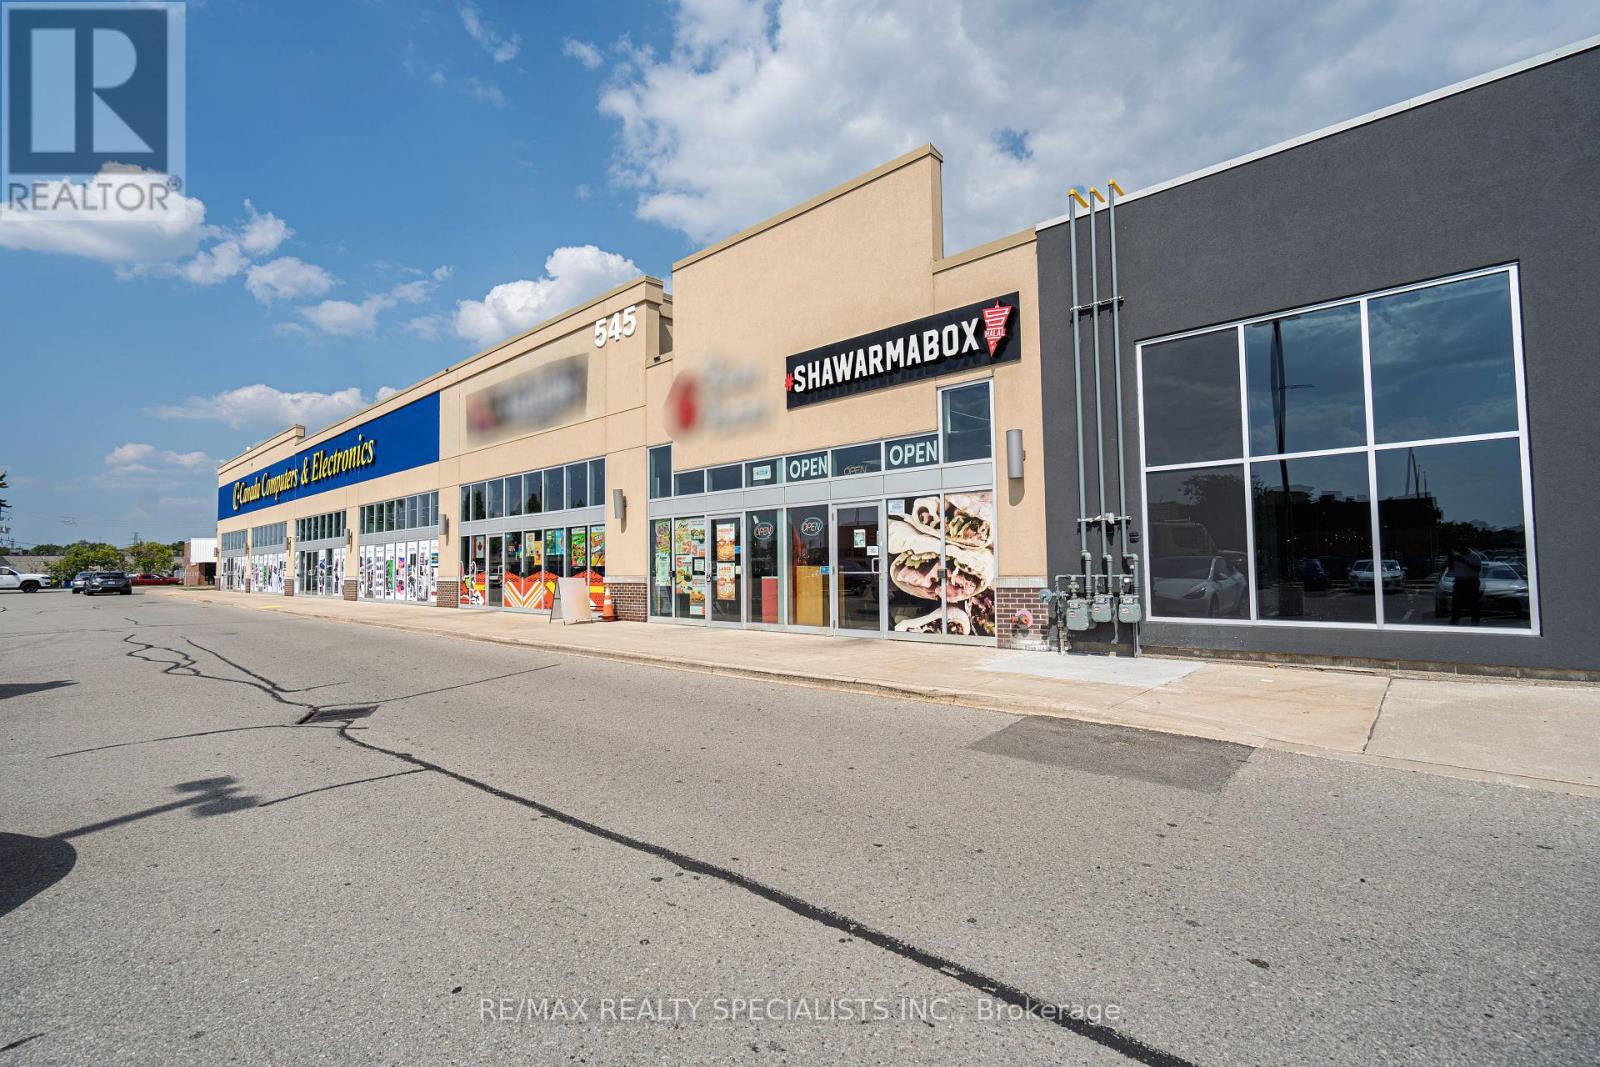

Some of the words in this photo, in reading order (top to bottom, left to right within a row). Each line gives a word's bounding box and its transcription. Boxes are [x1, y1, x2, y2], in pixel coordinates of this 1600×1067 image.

[594, 305, 637, 349] 545
[784, 317, 980, 393] #SHAWARMABOX
[889, 439, 939, 466] OPEN
[240, 476, 260, 504] Canada
[261, 468, 299, 500] Computers
[301, 456, 310, 485] &
[311, 433, 375, 481] Electronics
[789, 455, 829, 479] OPEN
[843, 465, 868, 476] OPEN
[754, 527, 773, 539] OPEN
[802, 522, 823, 534] OPEN
